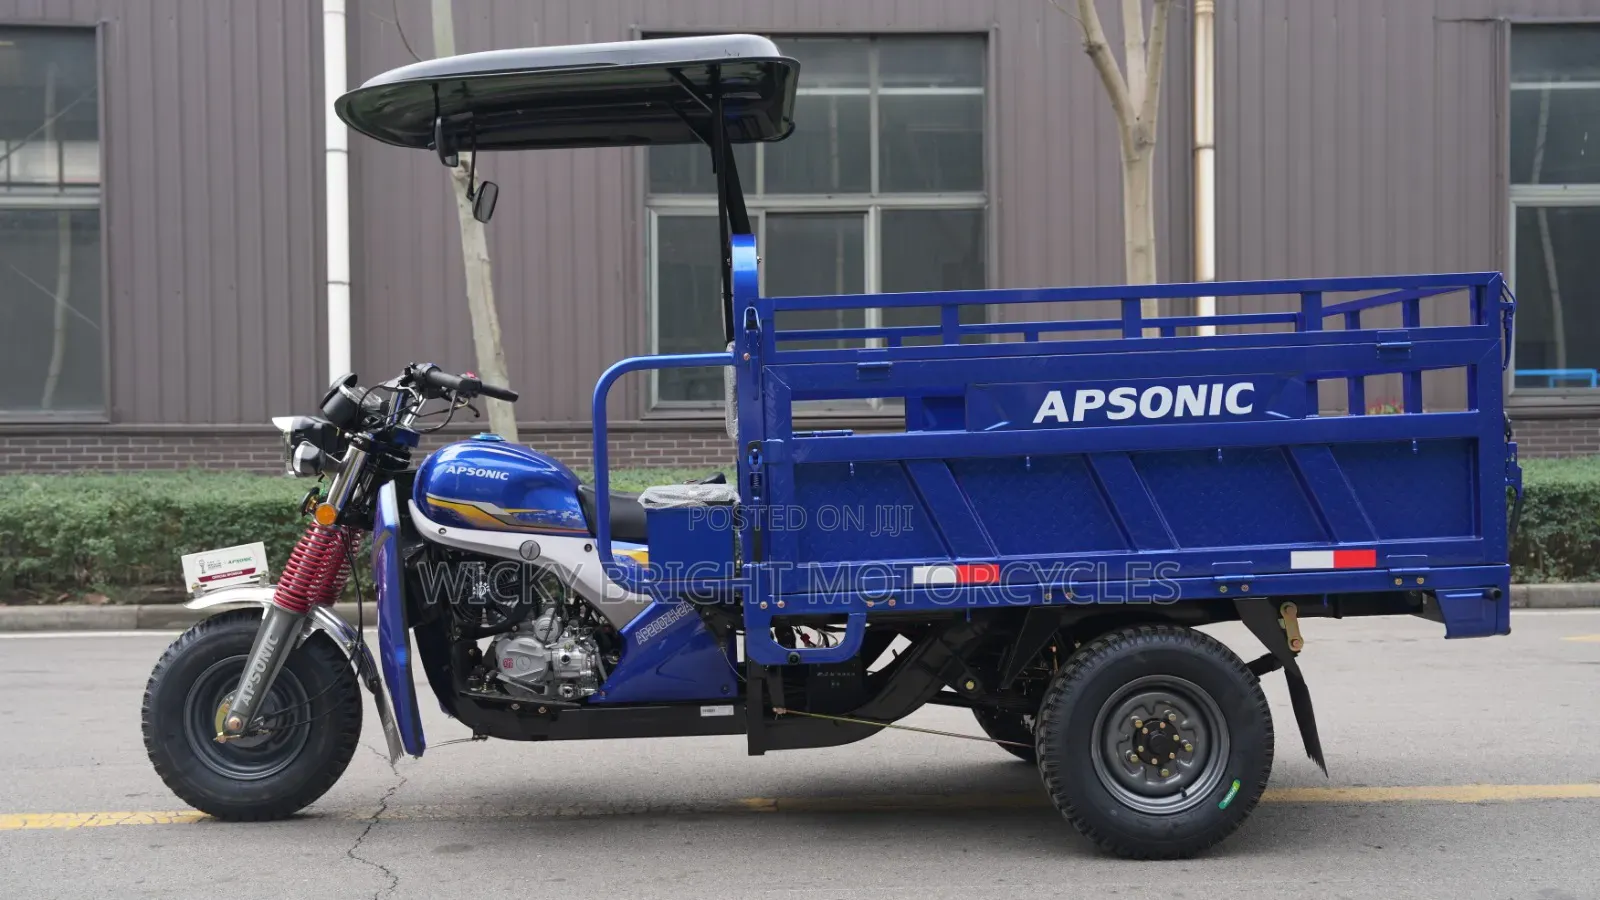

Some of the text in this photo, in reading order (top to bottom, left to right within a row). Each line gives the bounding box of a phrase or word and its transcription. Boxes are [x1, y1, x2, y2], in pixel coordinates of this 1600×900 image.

[1032, 382, 1255, 423] APSONIC
[445, 465, 510, 481] APSONIC
[242, 633, 279, 707] APSONIC
